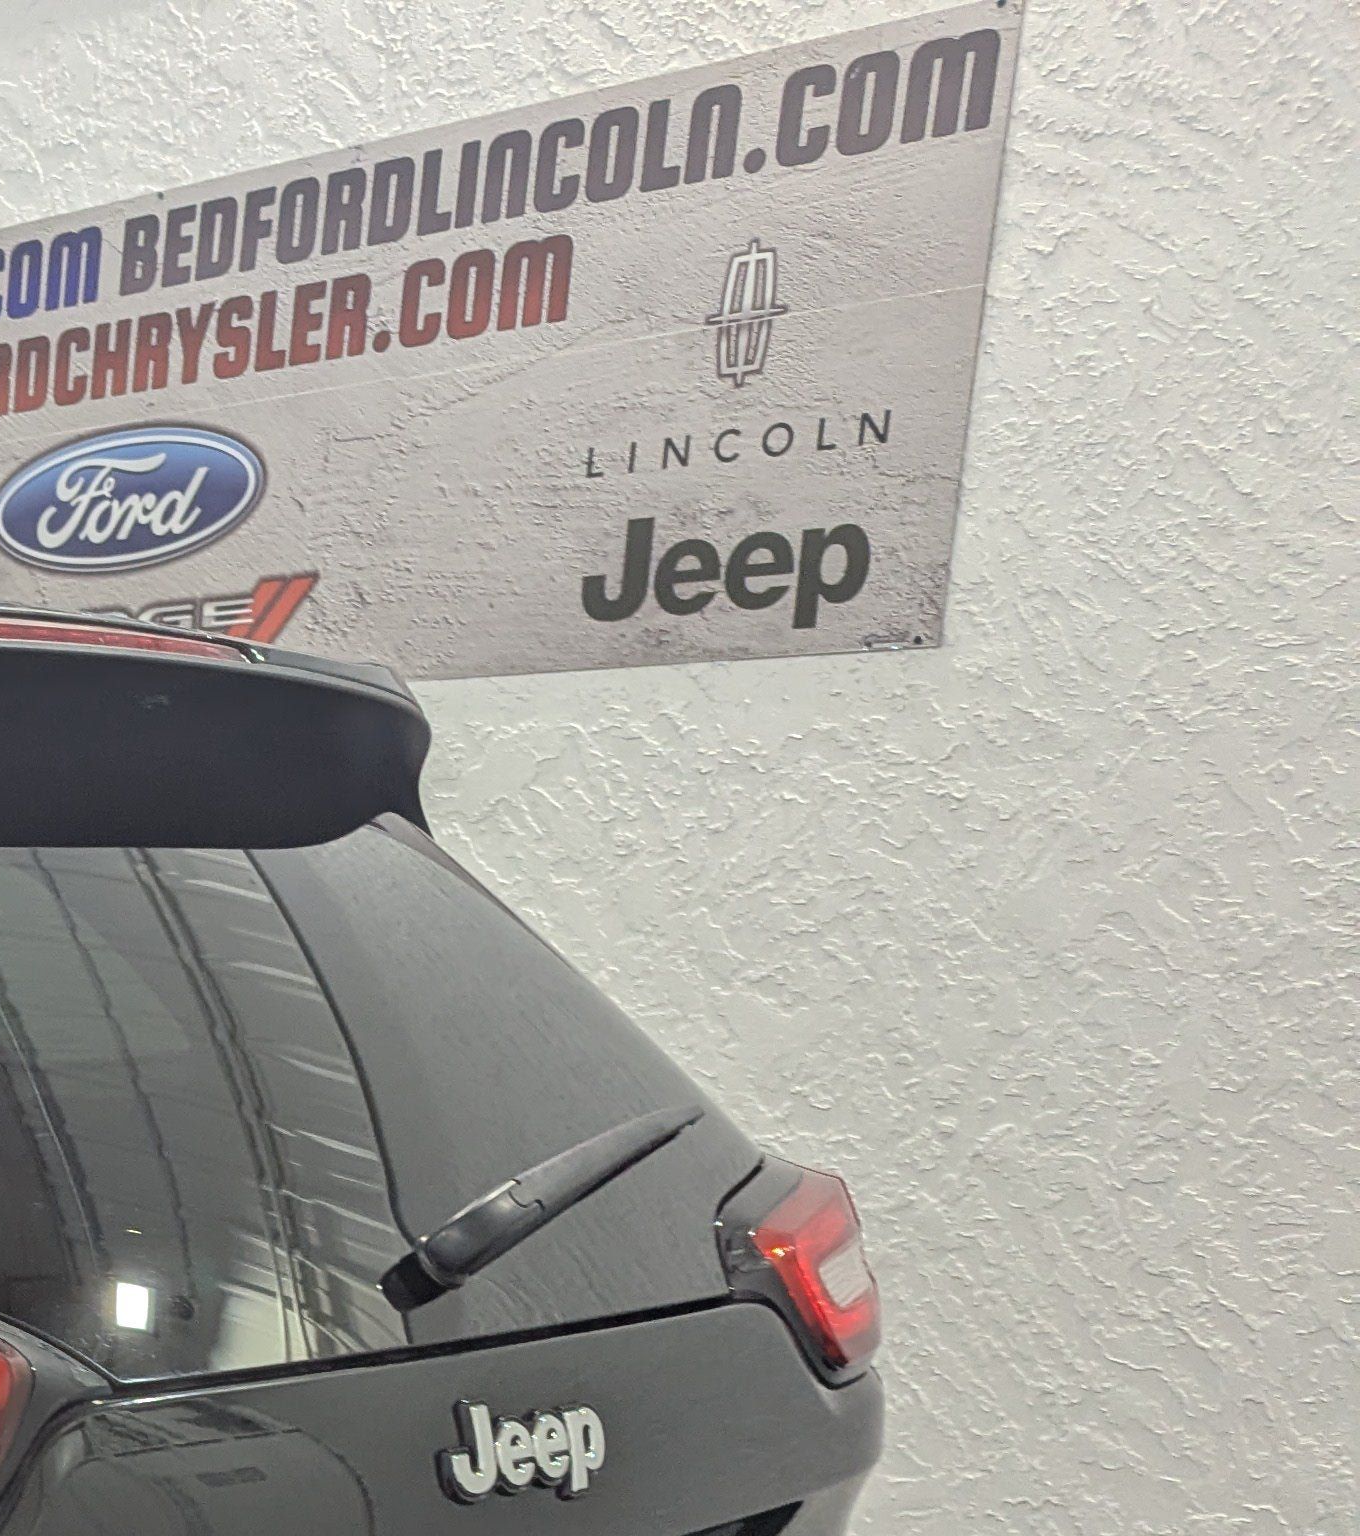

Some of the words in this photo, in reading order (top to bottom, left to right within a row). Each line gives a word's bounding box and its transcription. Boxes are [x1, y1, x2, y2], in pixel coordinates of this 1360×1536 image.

[119, 28, 1002, 296] BEDFORDLINCOLN.COM
[585, 408, 893, 479] LINCOLN
[36, 452, 209, 549] Ford
[580, 516, 872, 630] Jeep
[436, 1399, 606, 1503] Jeep
